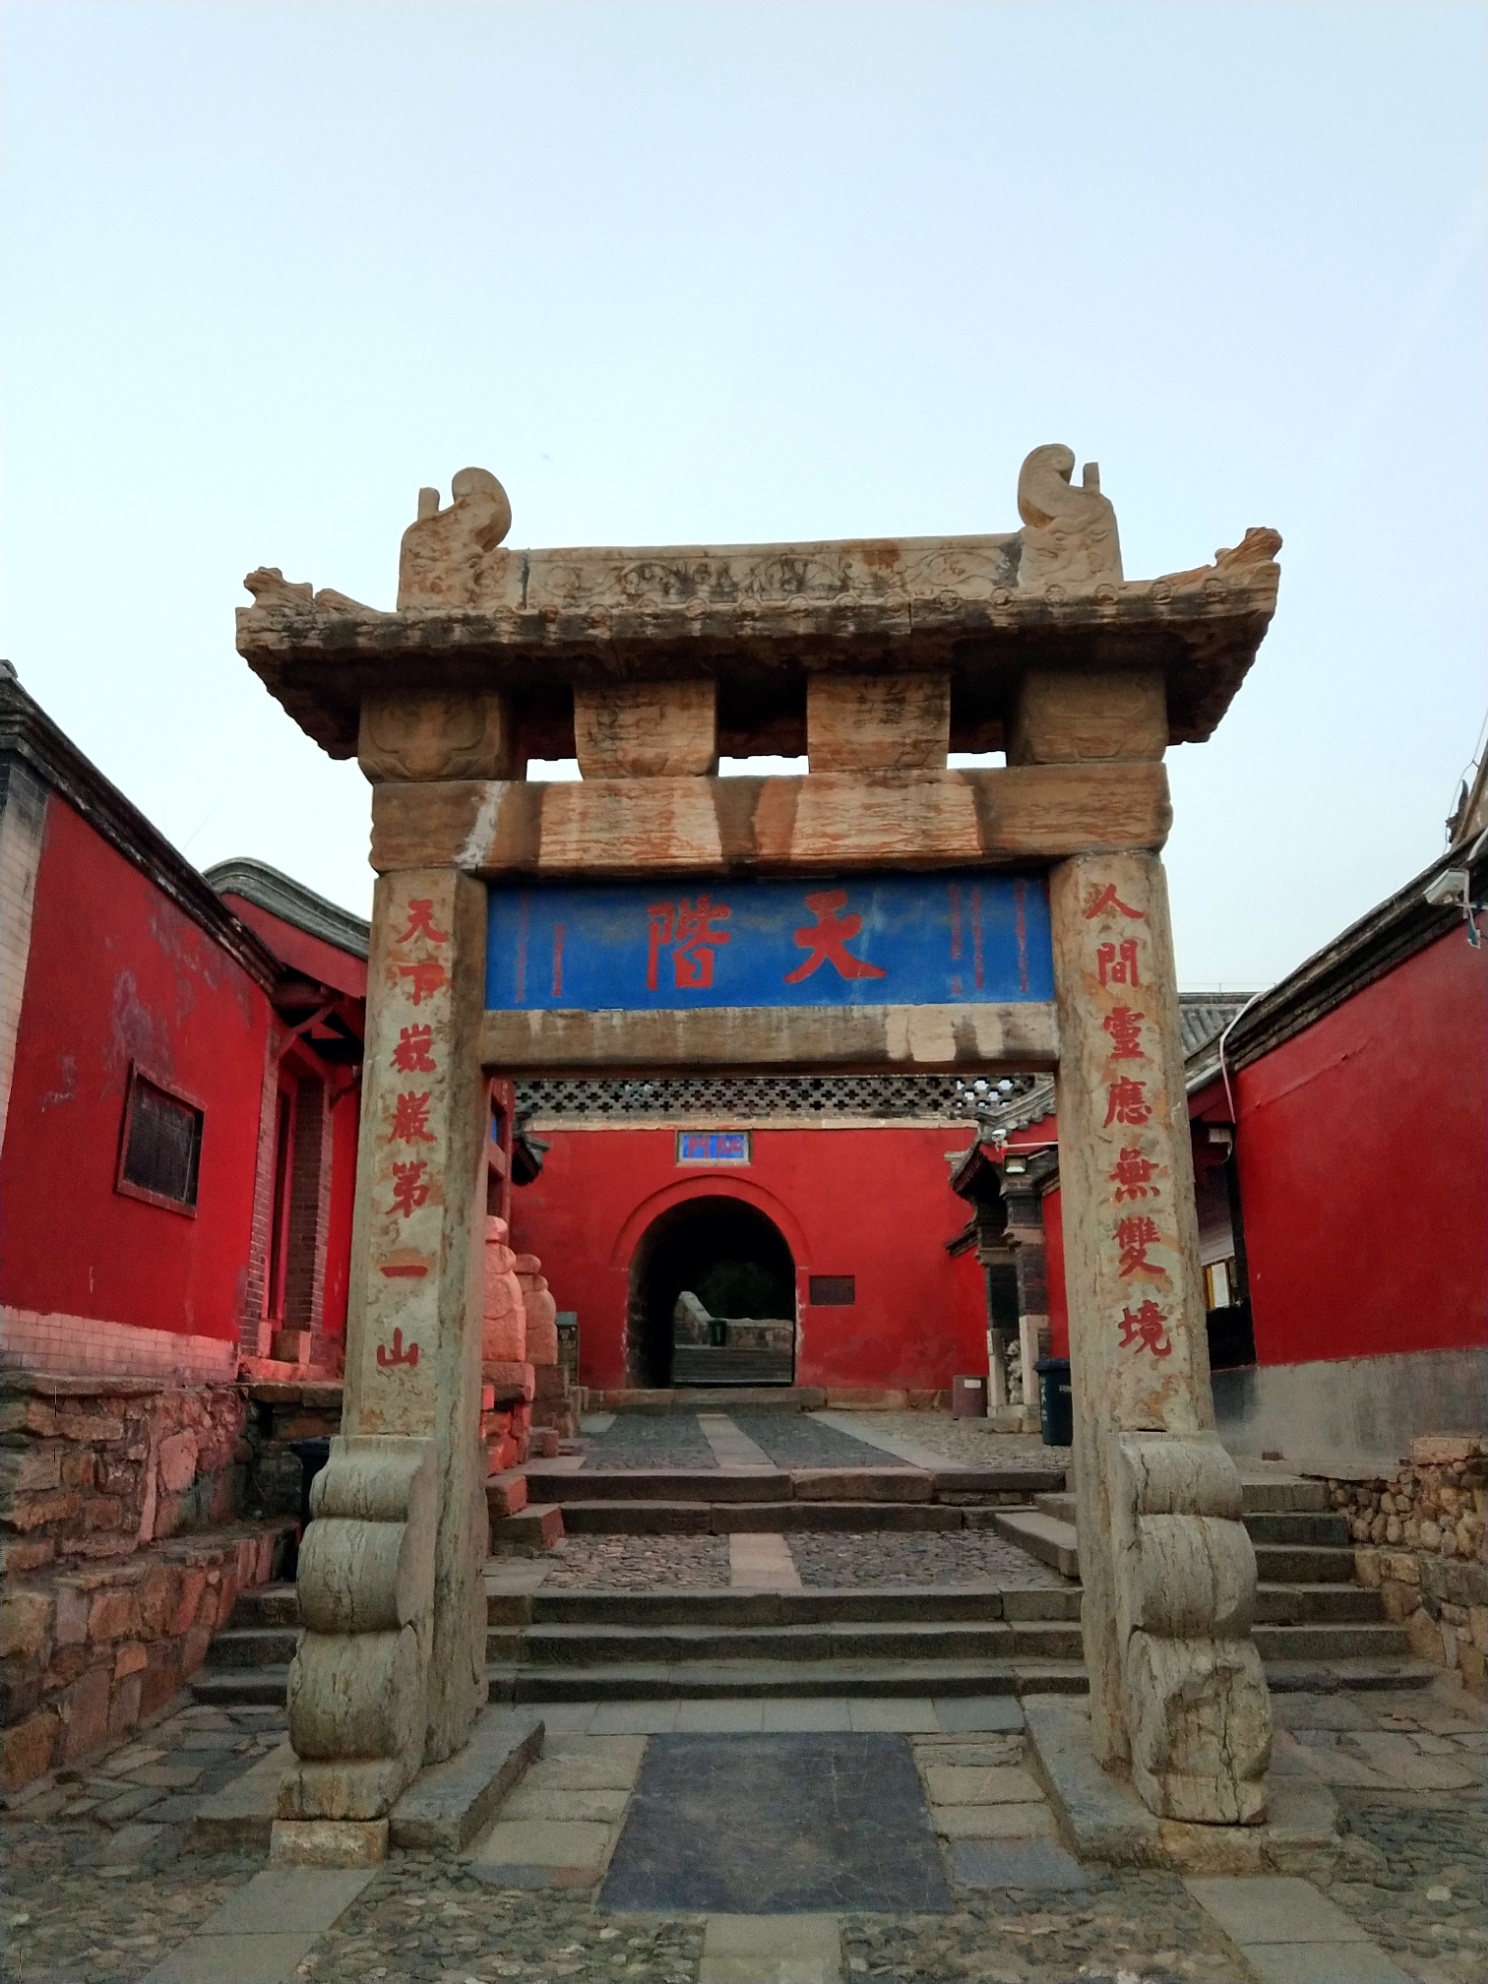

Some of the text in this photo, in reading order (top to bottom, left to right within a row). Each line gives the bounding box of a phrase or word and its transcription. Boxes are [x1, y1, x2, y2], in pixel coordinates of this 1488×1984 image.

[1086, 884, 1170, 1356] 人間靈應無雙境
